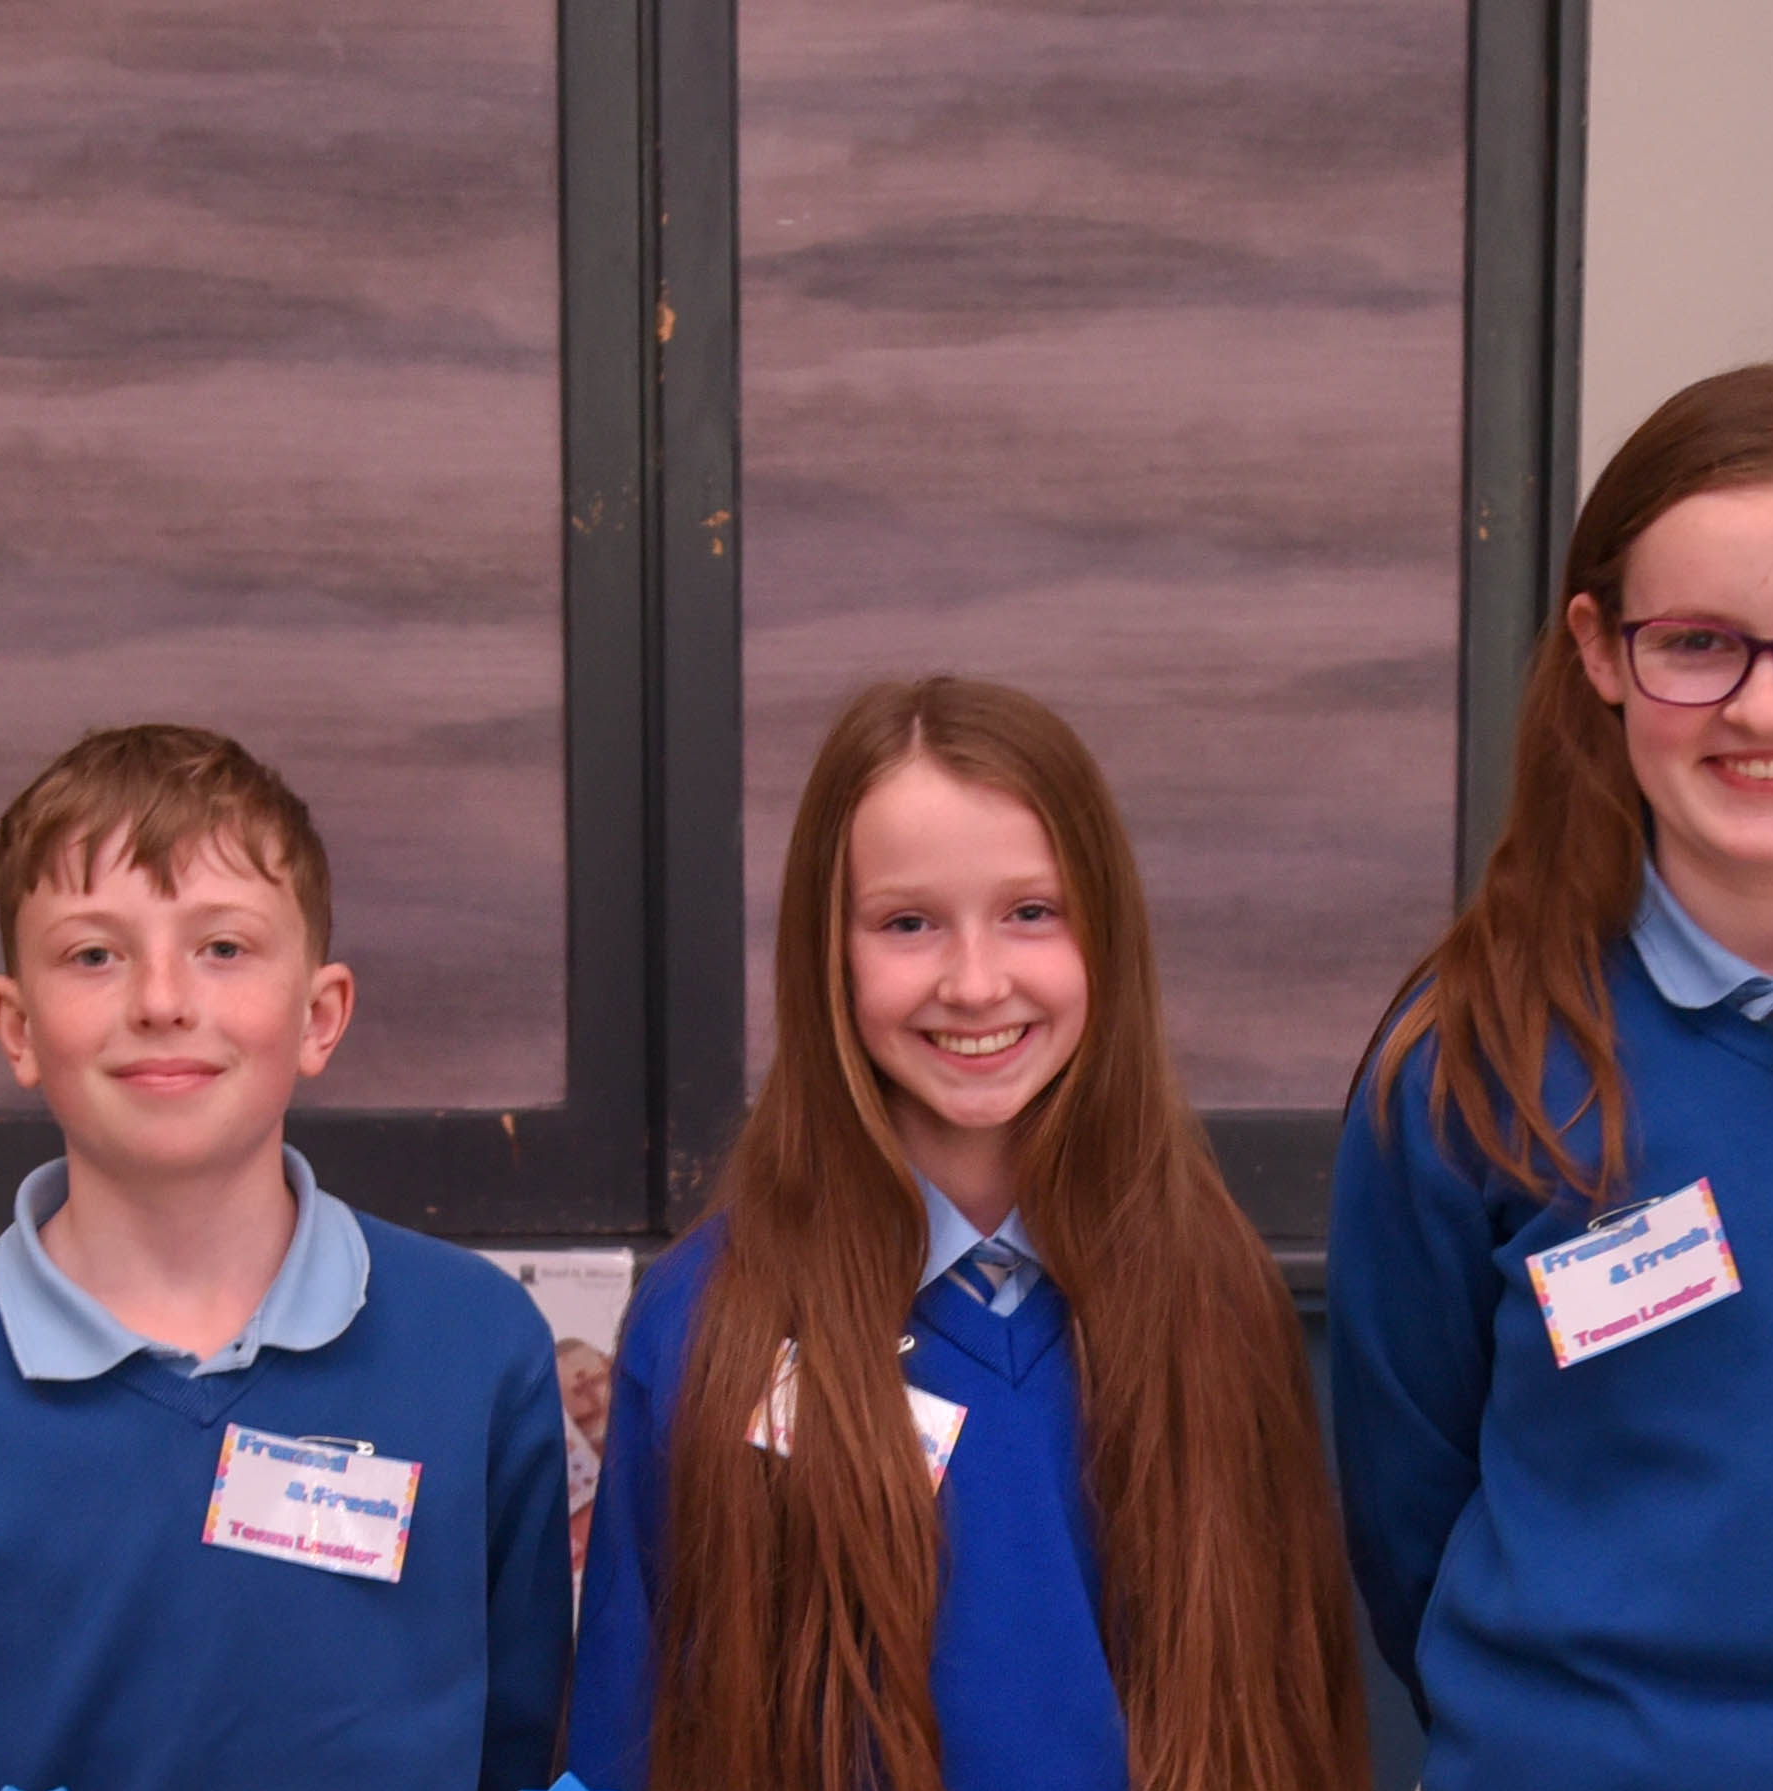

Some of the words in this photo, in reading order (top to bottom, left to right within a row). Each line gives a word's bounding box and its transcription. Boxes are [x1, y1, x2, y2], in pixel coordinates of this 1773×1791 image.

[1609, 1263, 1632, 1285] &
[1573, 1314, 1639, 1348] Team
[1638, 1277, 1717, 1322] Leader
[229, 1520, 294, 1549] Team
[294, 1536, 382, 1566] Leader
